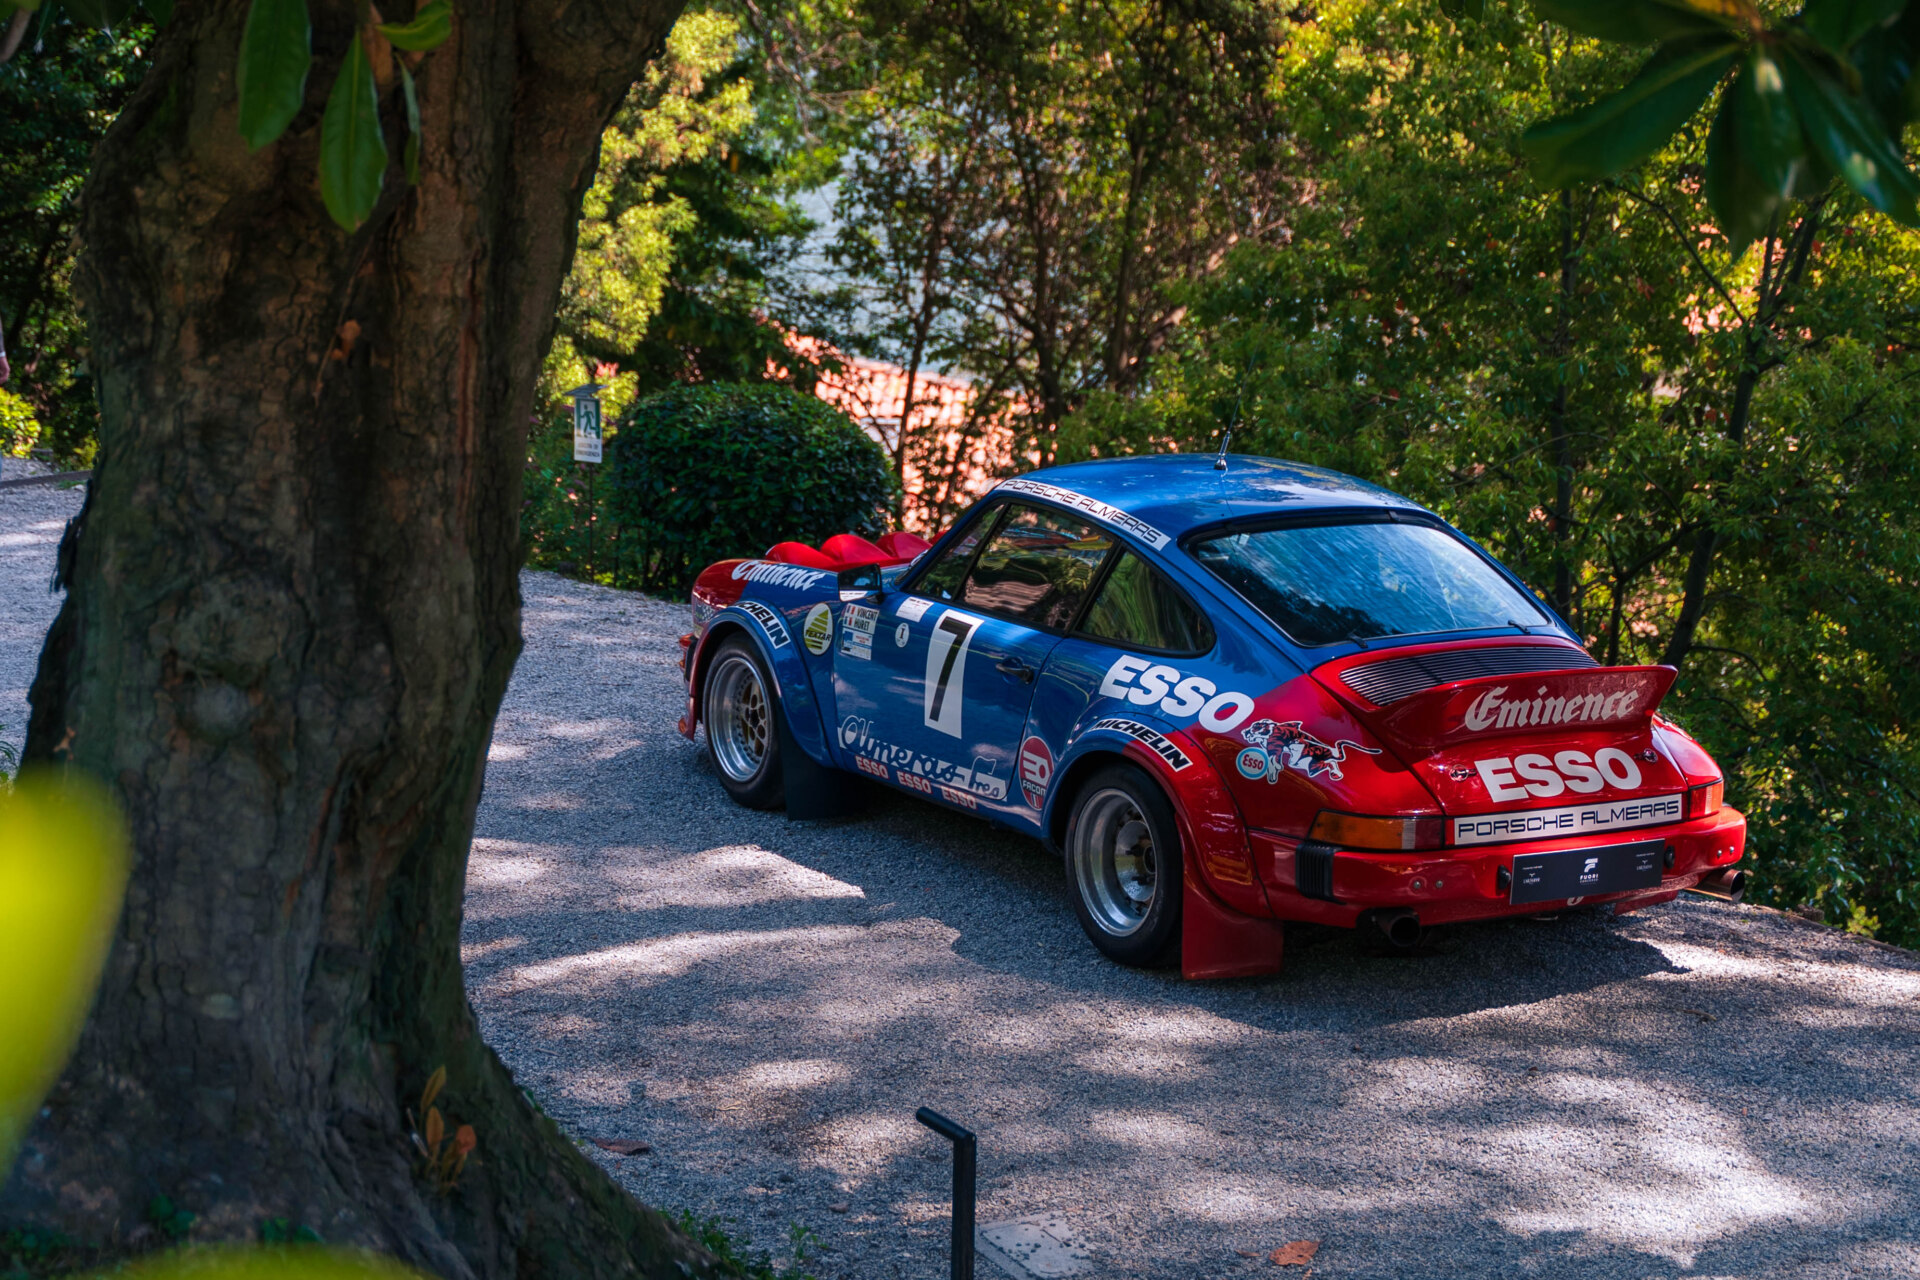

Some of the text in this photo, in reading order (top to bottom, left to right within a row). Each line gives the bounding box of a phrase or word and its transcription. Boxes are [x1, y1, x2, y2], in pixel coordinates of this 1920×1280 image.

[1002, 481, 1162, 544] PORSCHE ALMERAS
[731, 560, 826, 592] Eminence
[805, 629, 832, 641] TEXTAR
[929, 616, 975, 722] 7
[1099, 655, 1255, 733] ESSO
[1464, 685, 1639, 731] Eminence
[855, 755, 978, 810] ESSO ESSO ESSO
[1474, 748, 1642, 803] ESSO
[1458, 800, 1679, 838] PORSCHE ALMERAS
